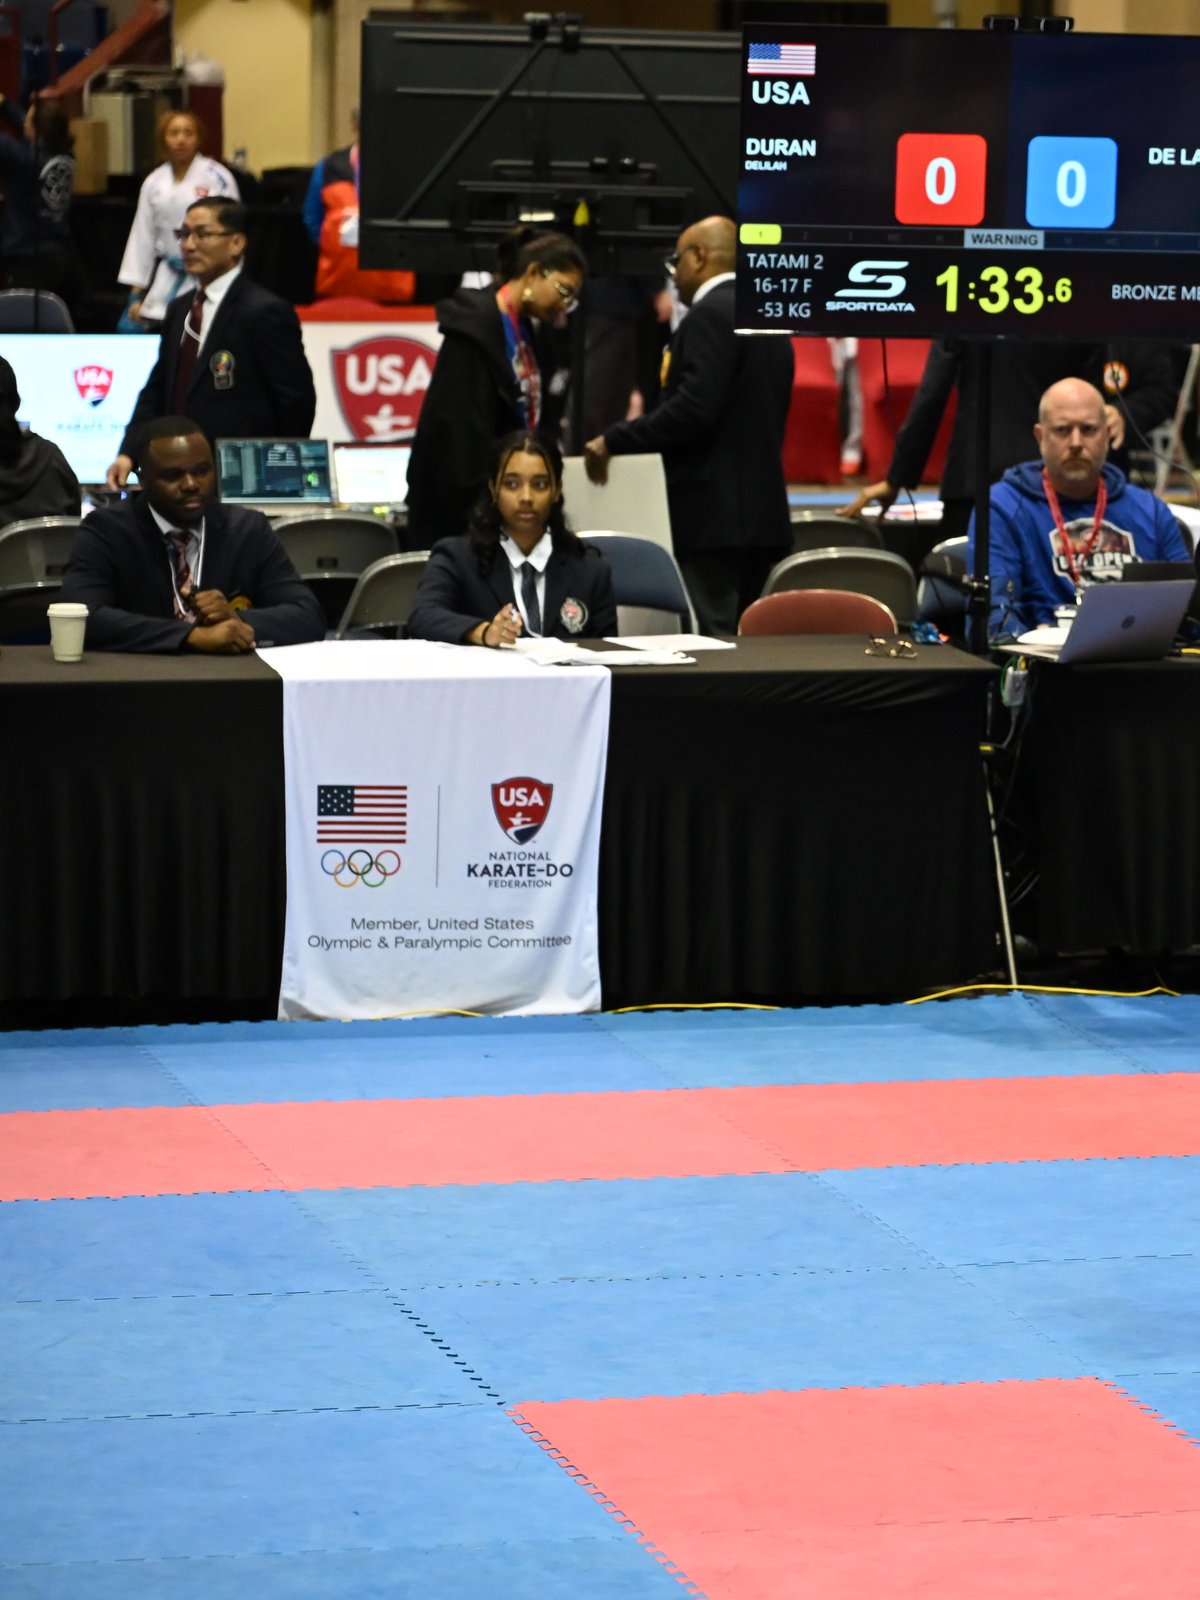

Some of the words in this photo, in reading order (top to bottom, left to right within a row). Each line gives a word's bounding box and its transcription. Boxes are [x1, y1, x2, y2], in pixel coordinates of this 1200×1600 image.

[752, 80, 811, 105] USA
[746, 138, 817, 157] DURAN
[1148, 148, 1176, 165] DE
[745, 160, 788, 171] DELILAH
[924, 157, 957, 205] 0
[1056, 160, 1087, 208] 0
[971, 233, 1039, 246] WARNING
[747, 253, 809, 270] TATAMI
[814, 254, 824, 270] 2
[754, 278, 798, 293] 16-17
[803, 278, 813, 293] F
[1111, 284, 1177, 300] BRONZE
[757, 302, 784, 318] -53
[788, 303, 812, 318] KG
[825, 301, 916, 313] SPORTDATA
[345, 354, 433, 396] USA
[499, 787, 545, 807] USA
[489, 851, 552, 861] NATIONAL
[467, 863, 574, 878] KARATE-DO
[488, 879, 552, 888] FEDERATION
[351, 918, 421, 932] Member,
[427, 918, 478, 931] United
[484, 917, 535, 930] States
[308, 935, 372, 951] Olympic
[377, 937, 390, 949] &
[395, 935, 483, 951] Paralympic
[487, 935, 573, 949] Committee
